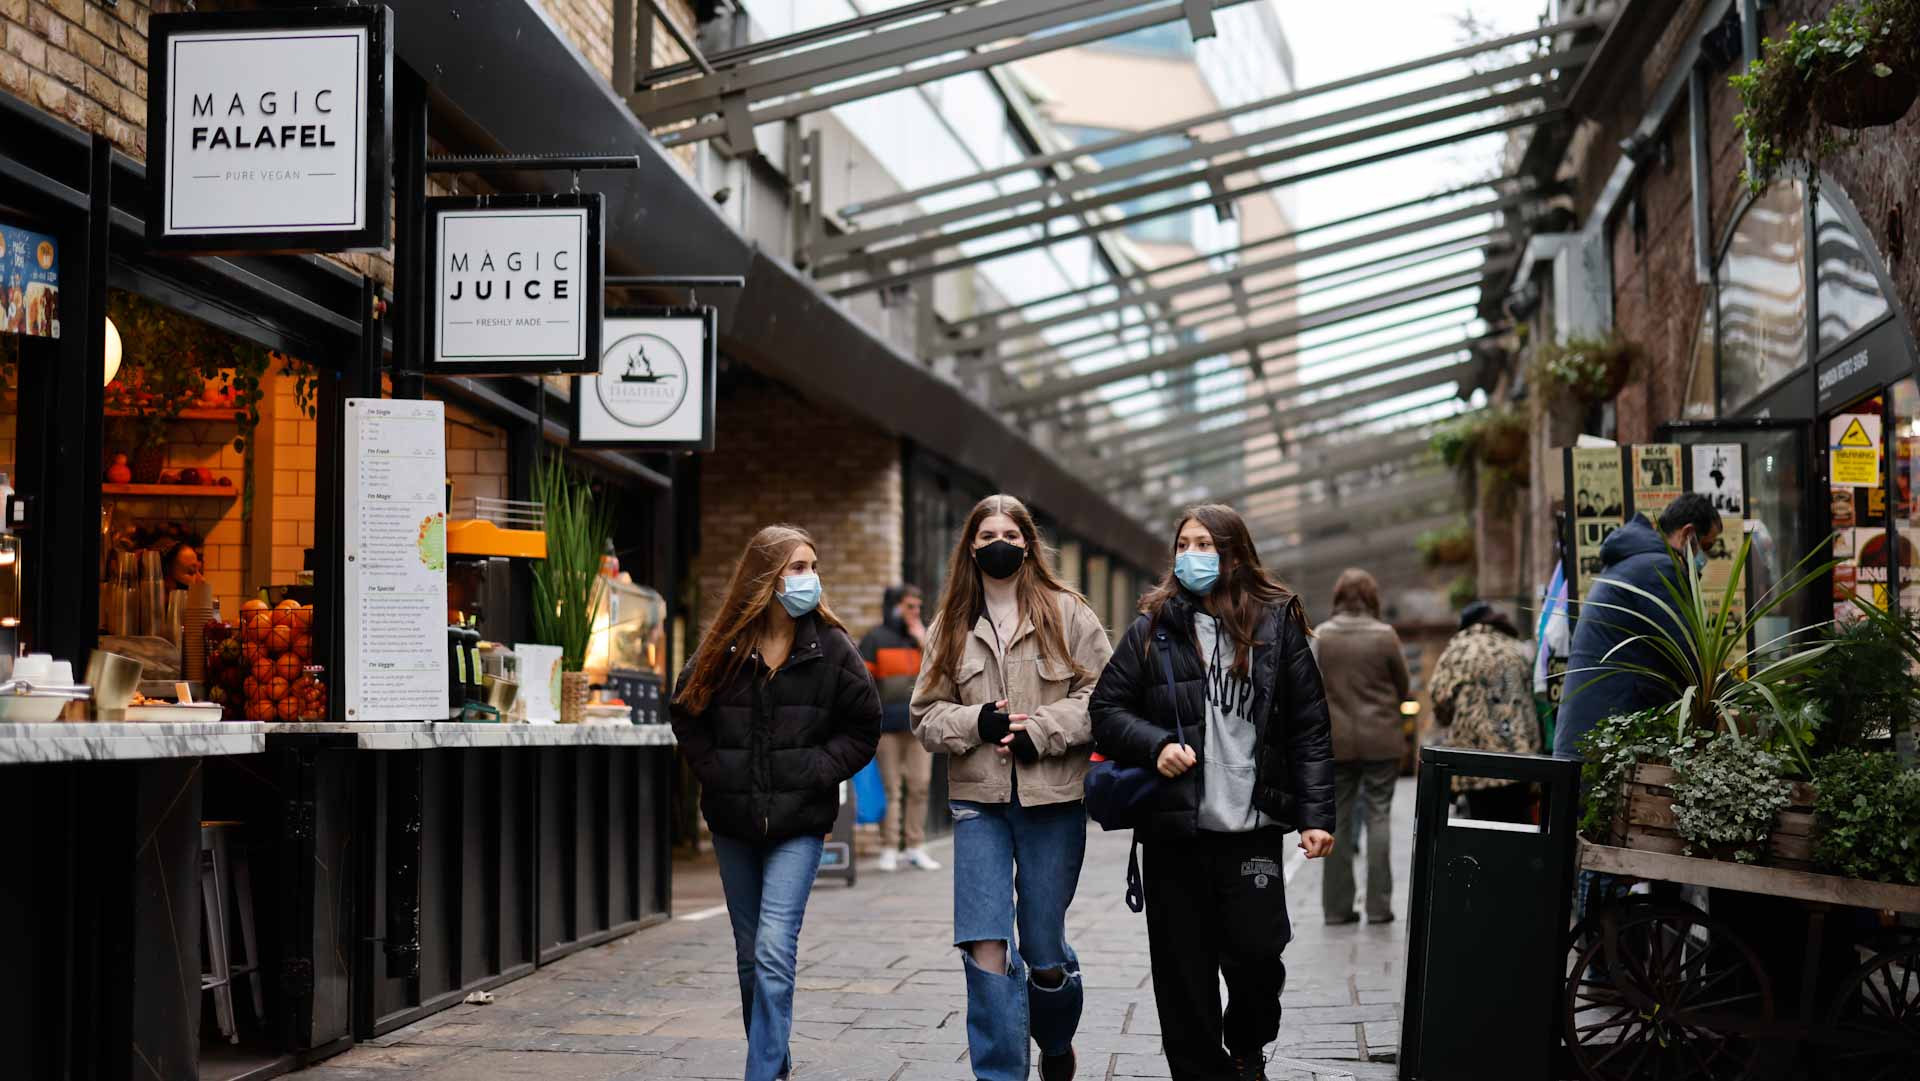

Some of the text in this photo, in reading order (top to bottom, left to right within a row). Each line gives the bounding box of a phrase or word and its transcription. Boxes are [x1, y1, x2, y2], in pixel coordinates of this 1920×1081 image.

[192, 89, 332, 116] MAGIC
[192, 124, 336, 149] FALAFEL
[226, 170, 300, 181] PURE VEGAN
[450, 251, 568, 272] MAGIC
[450, 280, 569, 300] JUICE
[476, 318, 542, 327] FRESHLY MADE
